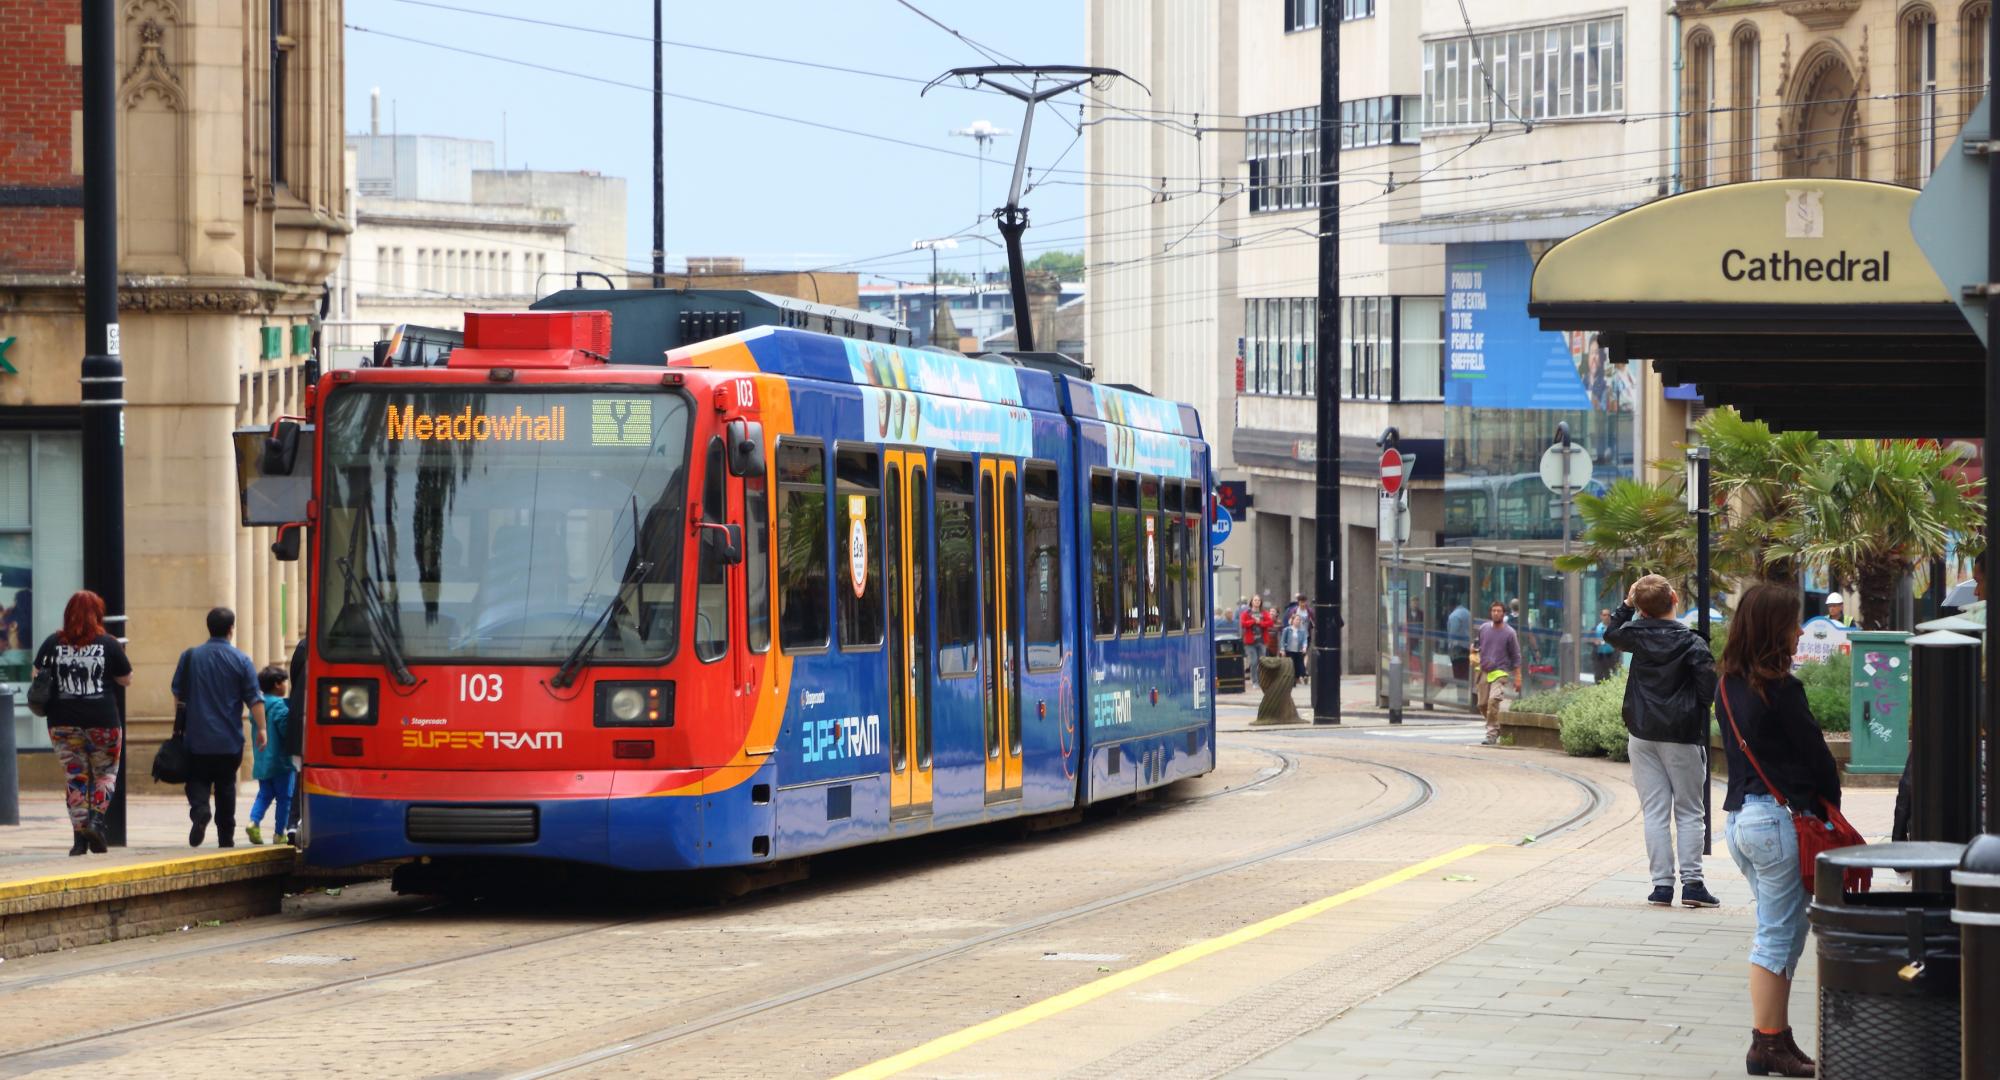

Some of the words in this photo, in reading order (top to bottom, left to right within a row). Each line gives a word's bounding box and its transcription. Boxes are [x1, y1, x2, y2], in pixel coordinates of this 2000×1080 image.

[1722, 249, 1889, 281] Cathedral
[1451, 271, 1473, 290] PROUD
[1473, 271, 1482, 290] TO
[1451, 292, 1466, 310] GIVE
[1466, 292, 1487, 310] EXTRA
[1451, 312, 1460, 330] TO
[1460, 312, 1473, 330] THE
[1451, 332, 1475, 350] PEOPLE
[1475, 332, 1484, 350] OF
[735, 379, 753, 407] 103
[388, 404, 566, 441] Meadowhall
[460, 673, 503, 702] 103
[411, 717, 448, 727] Stagecoach
[402, 730, 562, 749] SUPERTRAM
